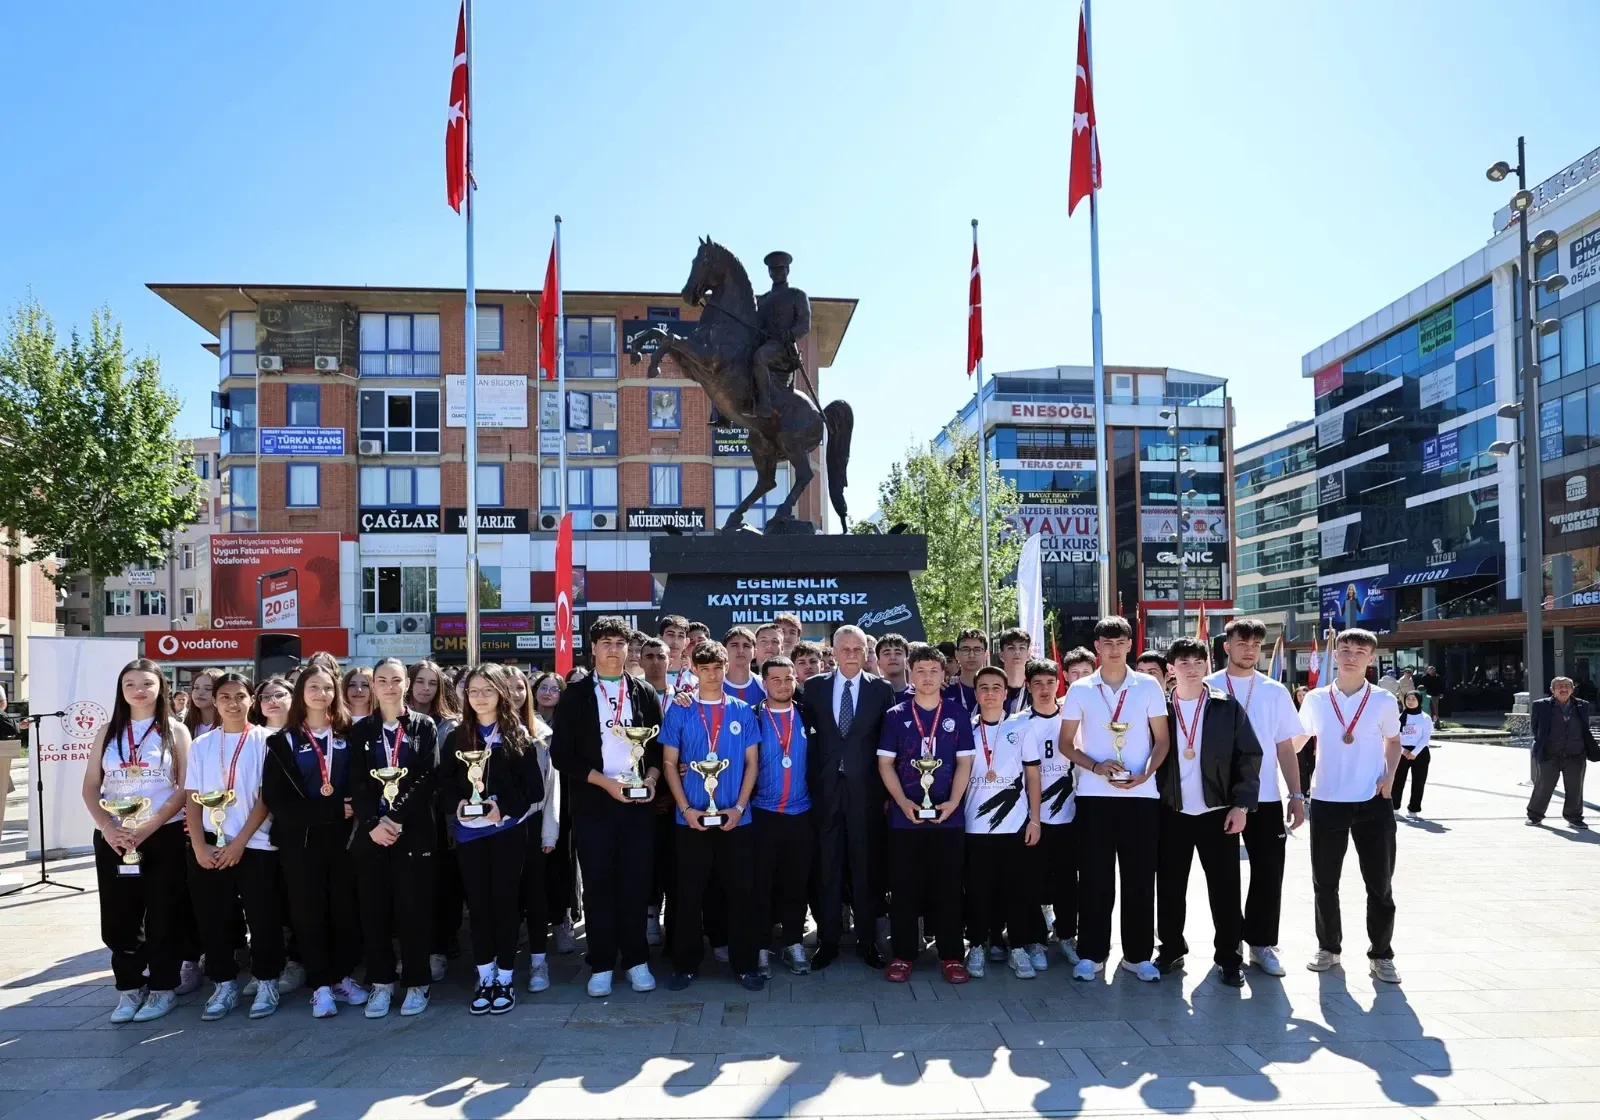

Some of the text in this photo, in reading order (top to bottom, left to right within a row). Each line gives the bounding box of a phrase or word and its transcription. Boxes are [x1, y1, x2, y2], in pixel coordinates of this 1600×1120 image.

[1571, 265, 1597, 285] 0545
[277, 434, 341, 445] TÜRKAN ŞANS
[1020, 460, 1083, 469] TERAS CAFE
[1566, 487, 1587, 498] KING
[1054, 507, 1069, 515] BİR
[361, 509, 439, 532] ÇAĞLAR
[458, 515, 516, 529] MMARLIK
[628, 510, 704, 528] MÜHENDİSLİK
[1062, 538, 1098, 549] KURS
[213, 547, 239, 556] Uygun
[240, 547, 269, 555] Faturalı
[1041, 551, 1098, 562] TANBU
[1403, 569, 1449, 584] EATFORD
[707, 593, 789, 606] KAYITSIZ
[264, 598, 296, 618] 20 GB
[181, 638, 239, 650] vodafone
[608, 697, 618, 711] 5
[1044, 739, 1054, 758] 8
